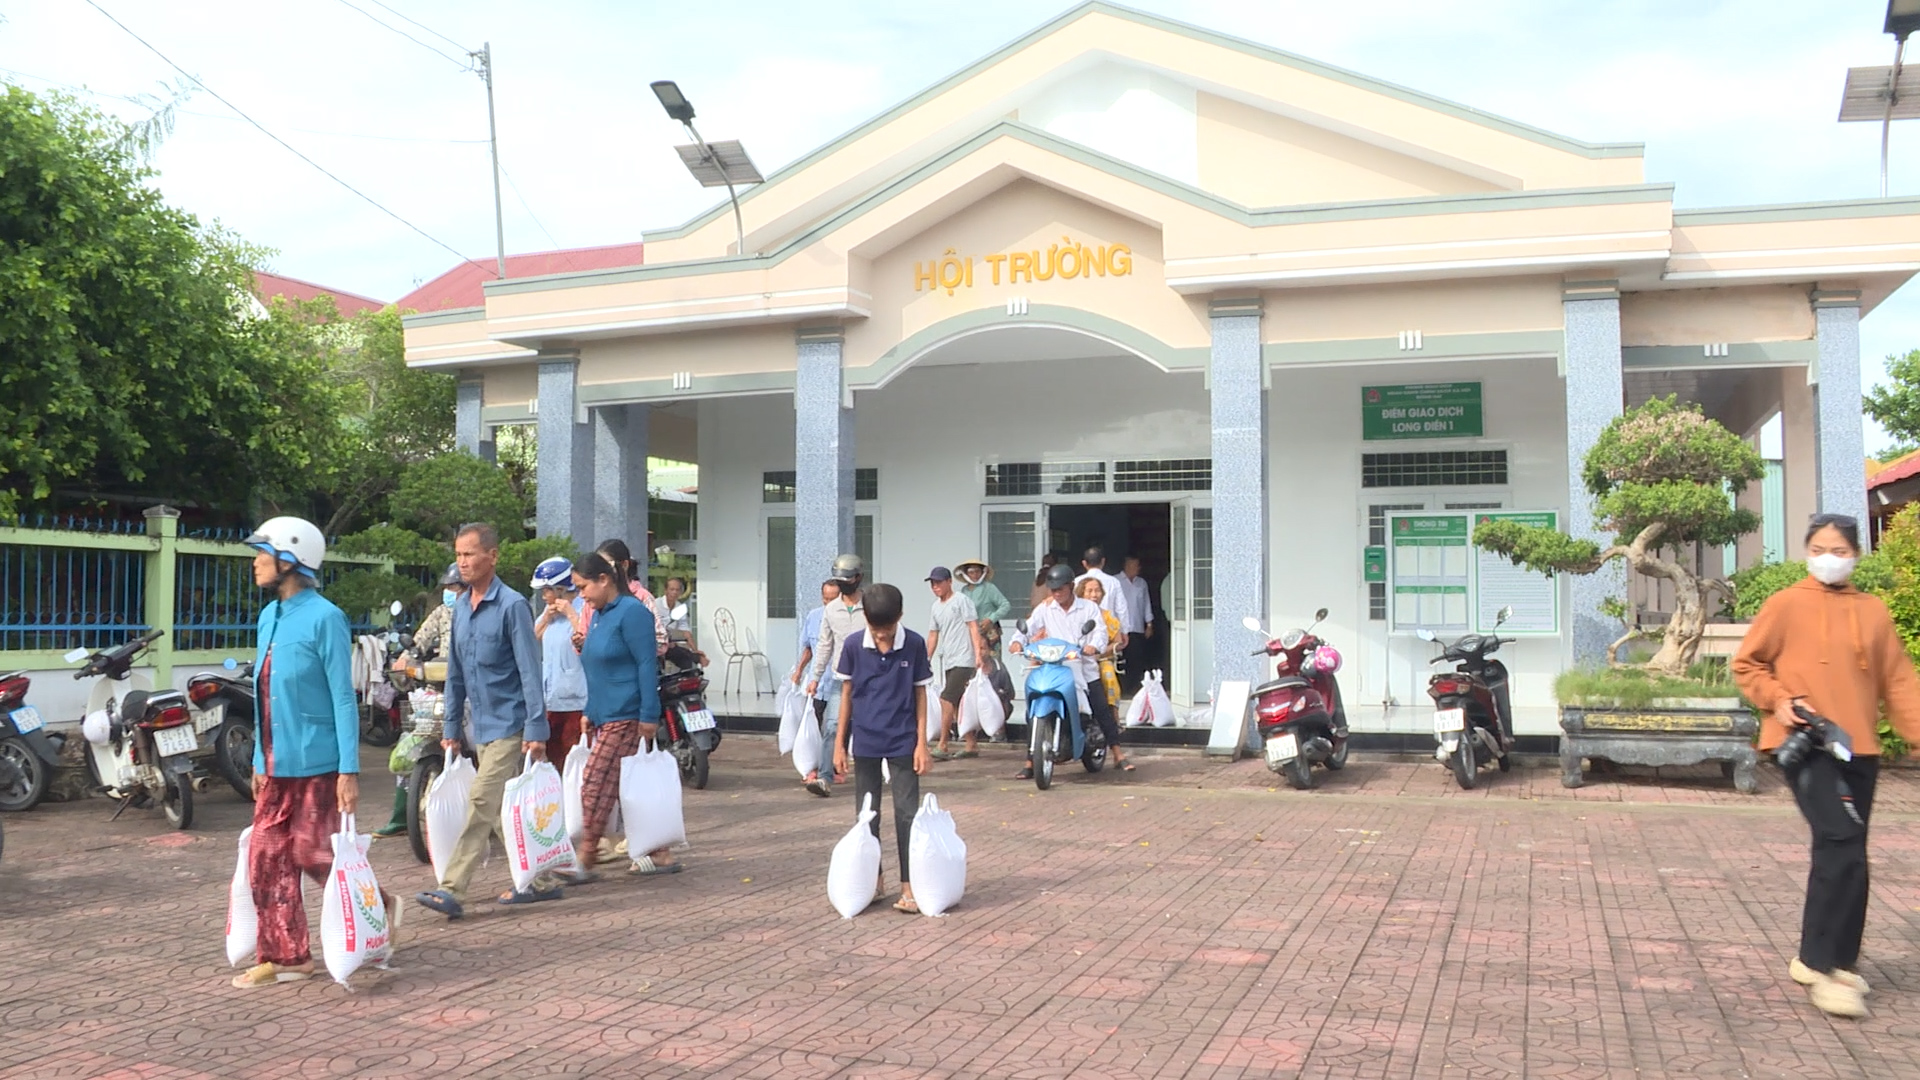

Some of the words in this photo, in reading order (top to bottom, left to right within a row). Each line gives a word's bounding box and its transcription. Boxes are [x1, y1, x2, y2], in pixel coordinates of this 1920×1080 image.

[914, 247, 973, 297] HỘI
[984, 235, 1132, 285] TRƯỜNG
[1408, 407, 1436, 418] GIAO
[1438, 406, 1464, 418] DỊCH
[1392, 422, 1421, 433] LONG
[1448, 420, 1454, 430] 1
